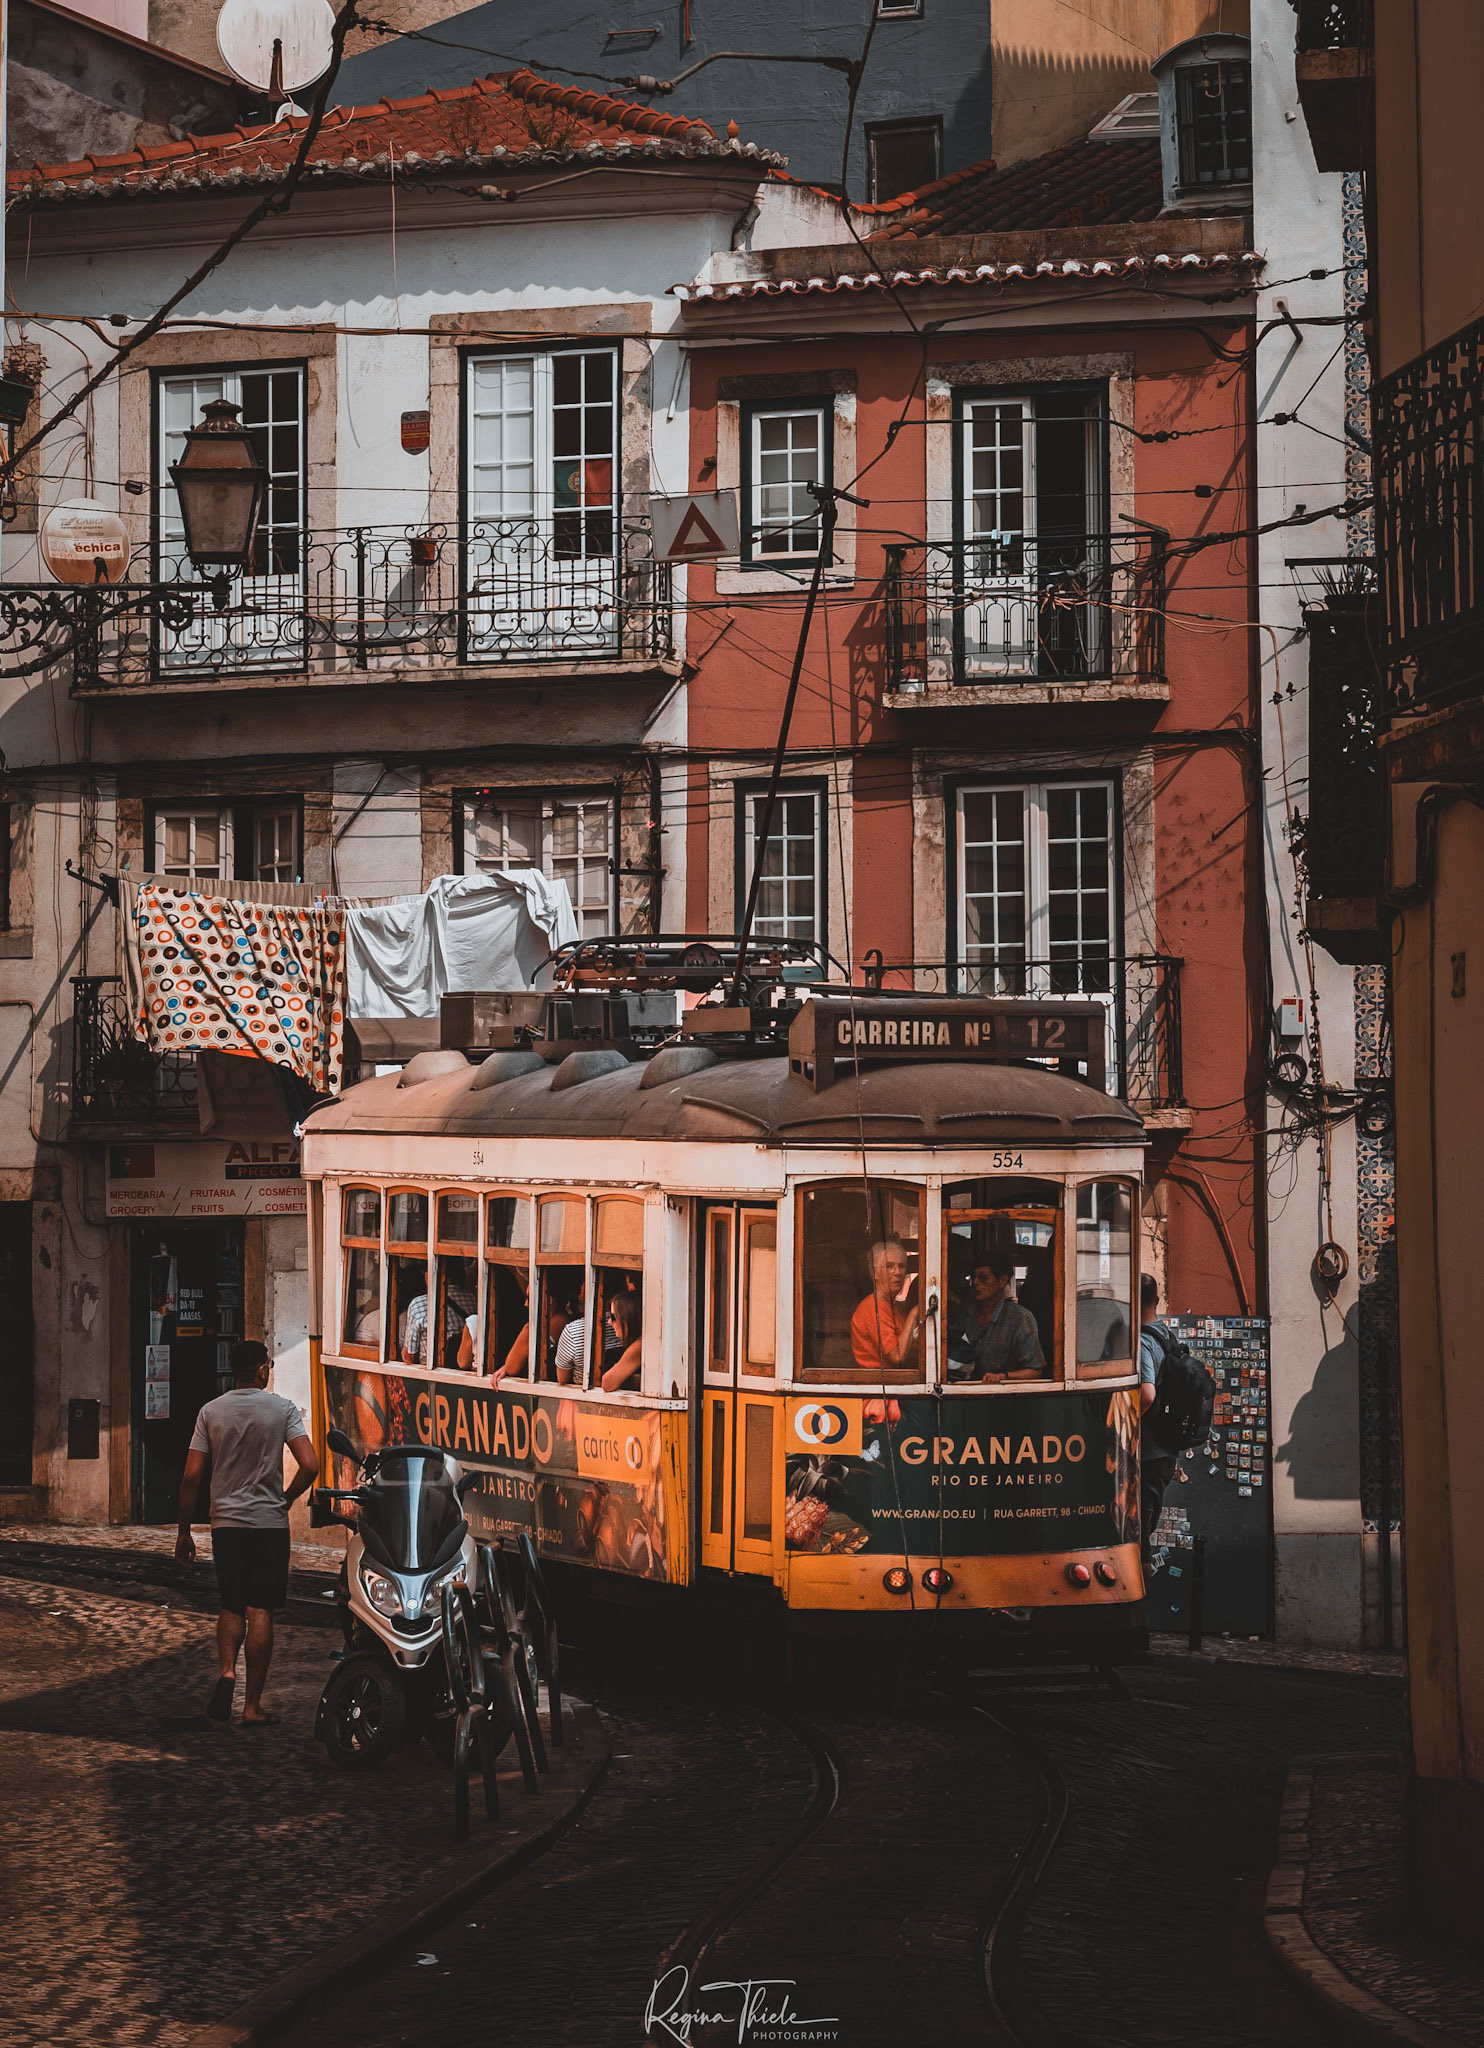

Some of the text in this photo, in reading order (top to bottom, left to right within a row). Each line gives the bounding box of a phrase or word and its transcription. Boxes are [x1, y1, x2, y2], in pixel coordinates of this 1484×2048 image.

[838, 1019, 951, 1045] CARREIRA
[1028, 1017, 1065, 1048] 12
[473, 1152, 484, 1165] 554
[993, 1152, 1023, 1168] 554
[238, 1166, 291, 1177] PREÇO
[110, 1190, 165, 1199] MERCEARIA
[190, 1189, 236, 1198] FRUTARIA
[110, 1206, 157, 1215] GROCERY
[191, 1204, 224, 1213] FRUITS
[415, 1392, 553, 1464] GRANADO
[583, 1430, 620, 1462] carris
[900, 1434, 1086, 1465] GRANADO
[931, 1473, 1064, 1486] RIO DE JANEIRO
[482, 1475, 536, 1502] JANEIRO
[871, 1508, 976, 1520] WWW.GRANADO.EU
[993, 1508, 1014, 1519] RUA
[1016, 1507, 1059, 1519] GARRETT,
[1060, 1507, 1071, 1517] 98
[1078, 1504, 1106, 1515] CHIADO
[482, 1516, 495, 1531] RUA
[537, 1527, 563, 1544] CHIADO
